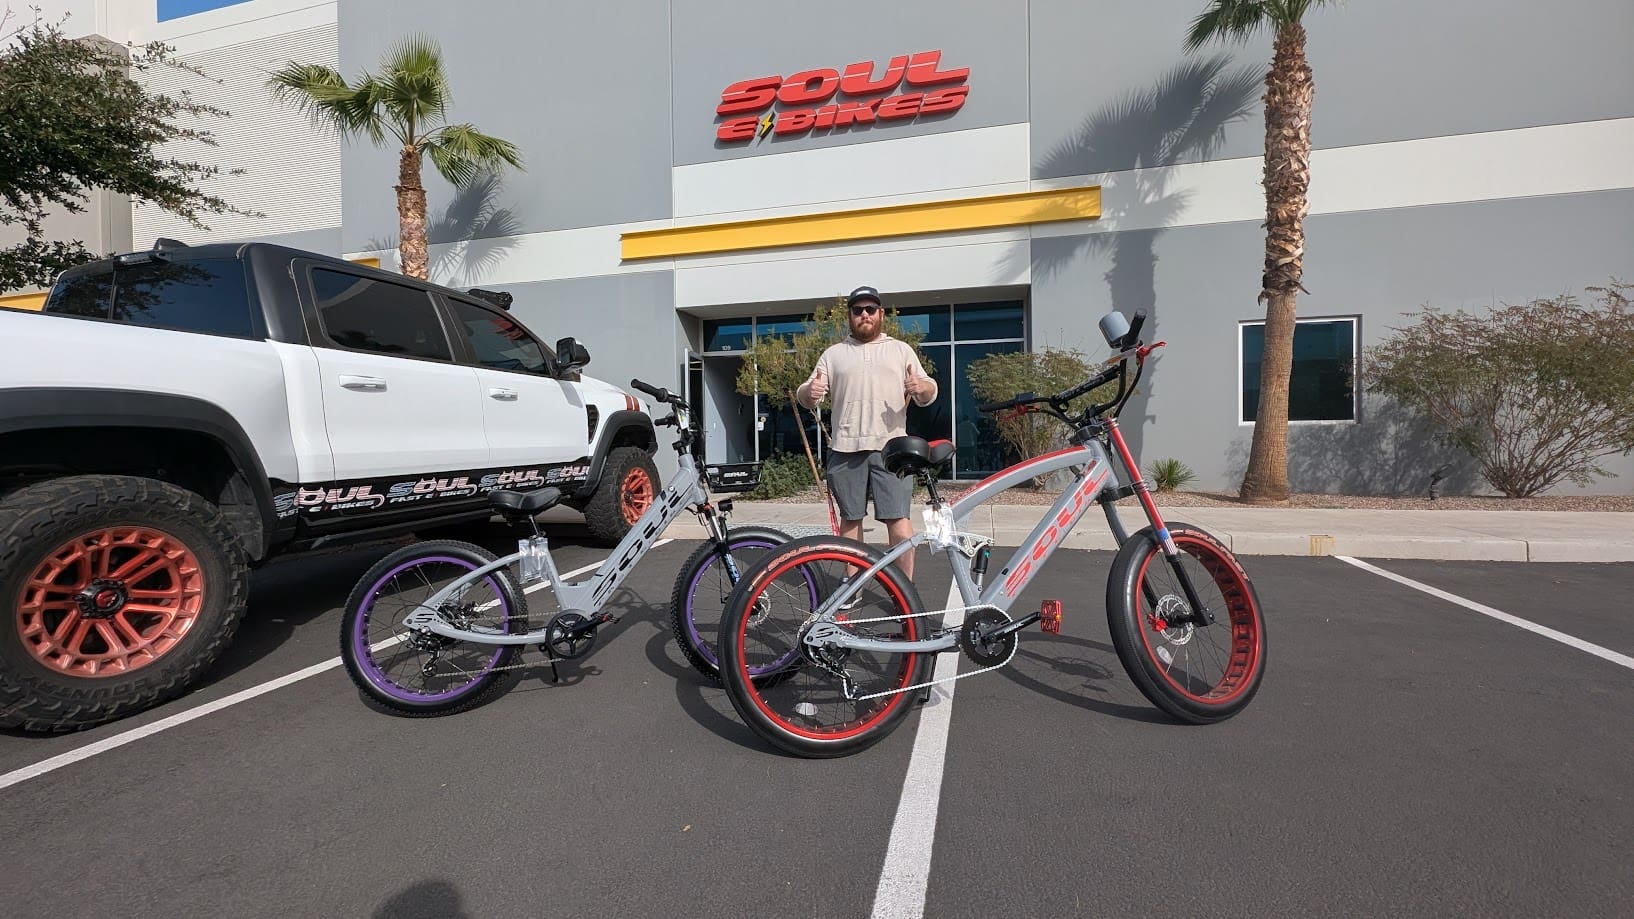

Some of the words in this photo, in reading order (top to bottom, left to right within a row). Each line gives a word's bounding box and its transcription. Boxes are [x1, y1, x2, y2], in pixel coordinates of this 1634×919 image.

[716, 50, 970, 116] SOUL
[774, 85, 970, 135] BIKES
[274, 485, 385, 512] SOUL
[386, 477, 478, 498] SOUL
[478, 470, 545, 488] SOUL
[592, 483, 694, 607] SOUL
[1005, 468, 1108, 598] SOUL
